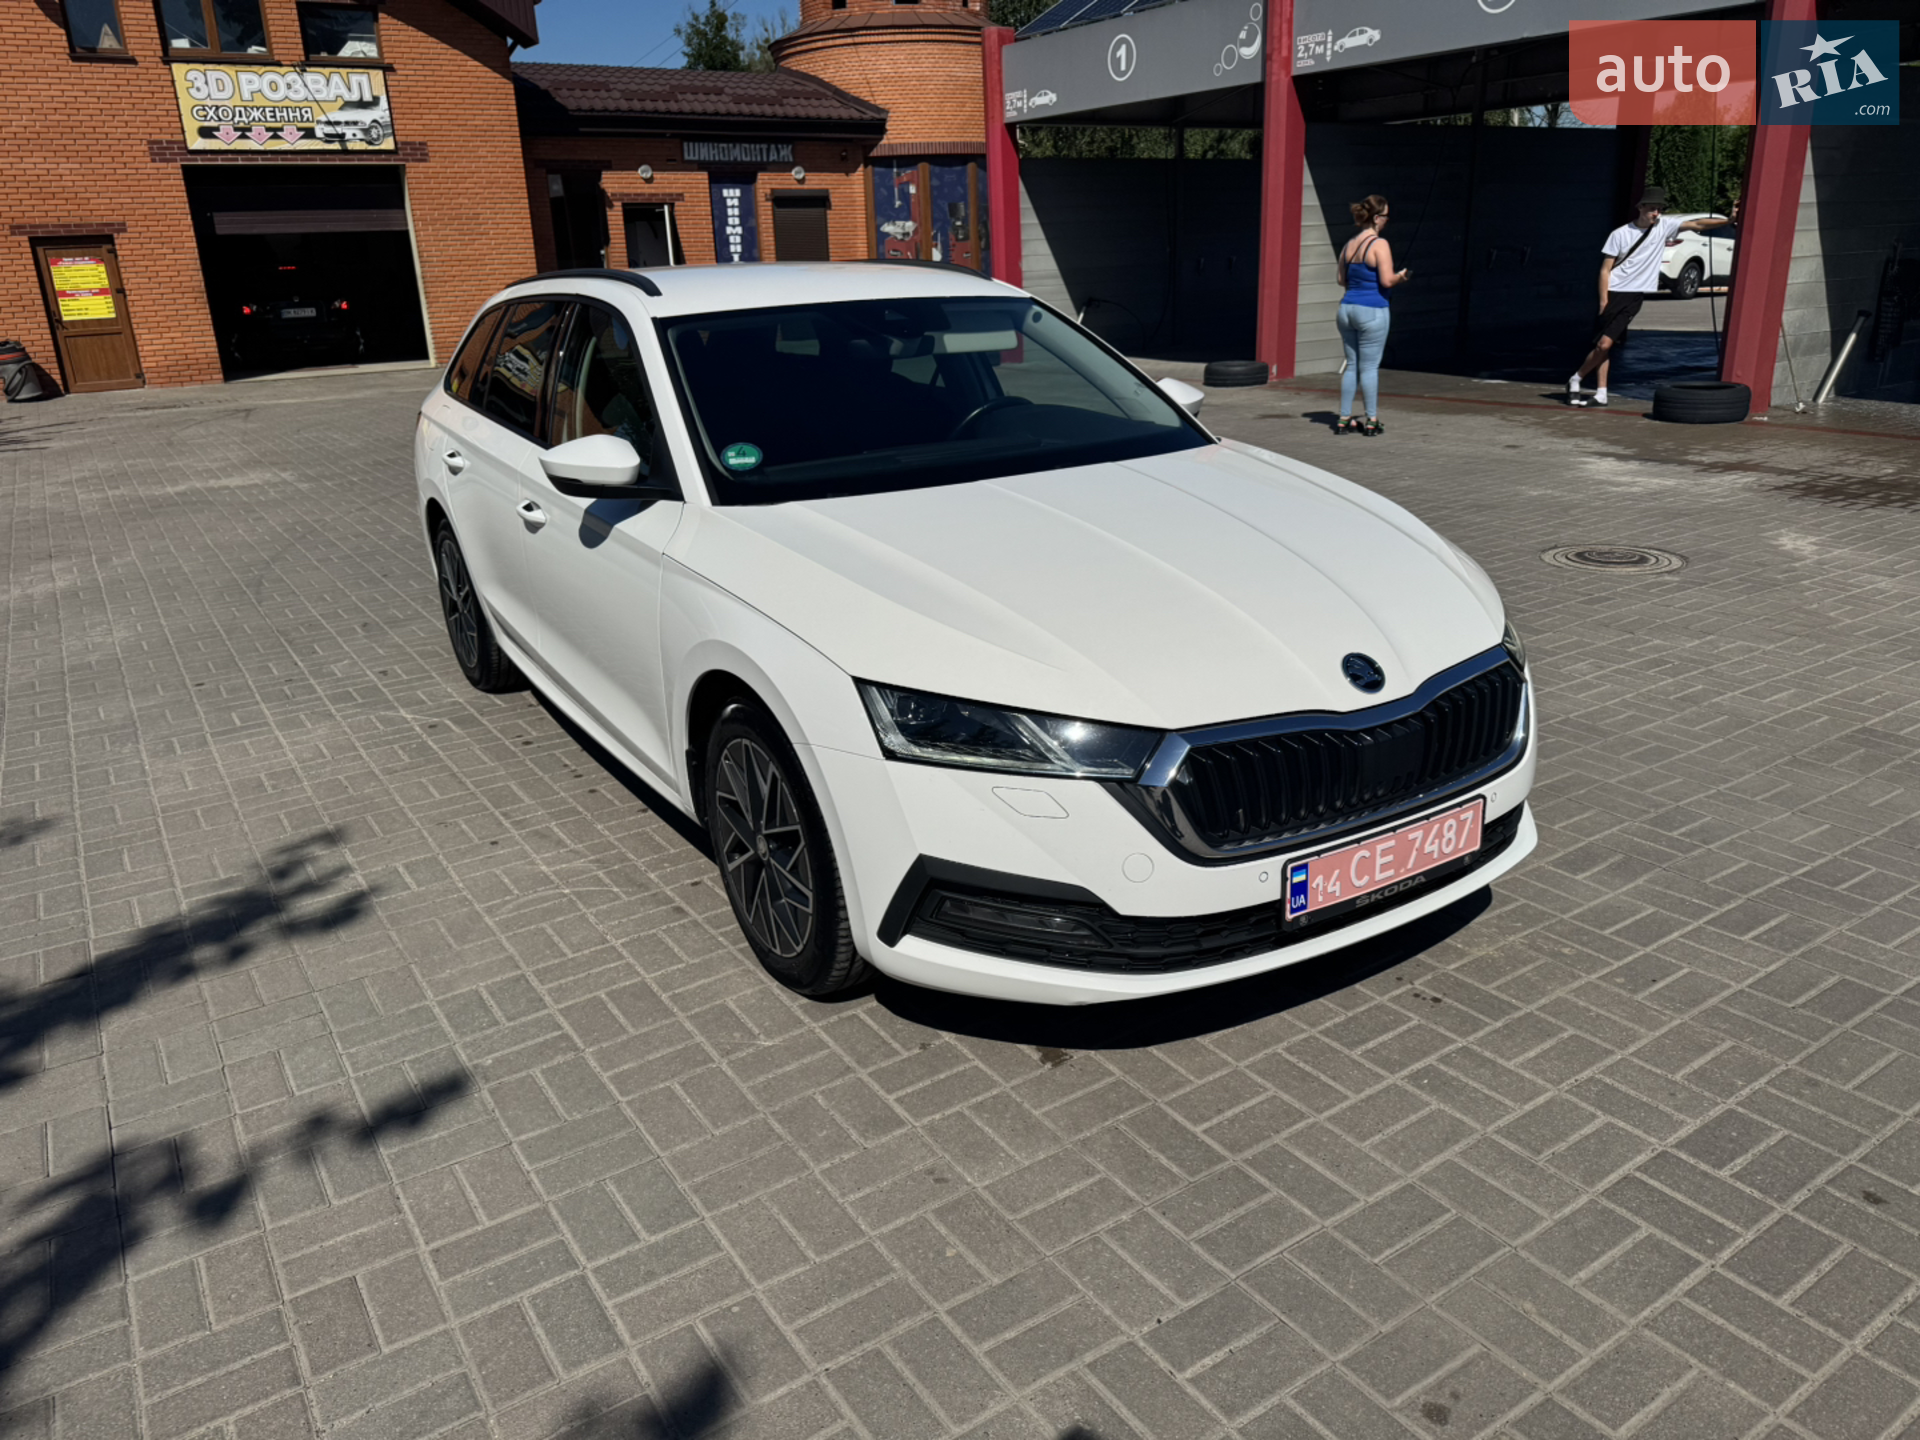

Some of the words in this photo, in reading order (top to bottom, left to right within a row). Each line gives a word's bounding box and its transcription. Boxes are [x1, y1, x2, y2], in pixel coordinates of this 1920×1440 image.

[1116, 44, 1126, 71] 1
[185, 69, 236, 101] 3D
[236, 71, 374, 102] РОЗВАЛ
[193, 105, 313, 124] СХОДЖЕННЯ
[683, 142, 793, 162] ШИНОМОНТАЖ
[1312, 869, 1341, 902] 14
[1350, 840, 1396, 888] CE
[1407, 810, 1474, 870] 7487
[1291, 894, 1306, 909] UA
